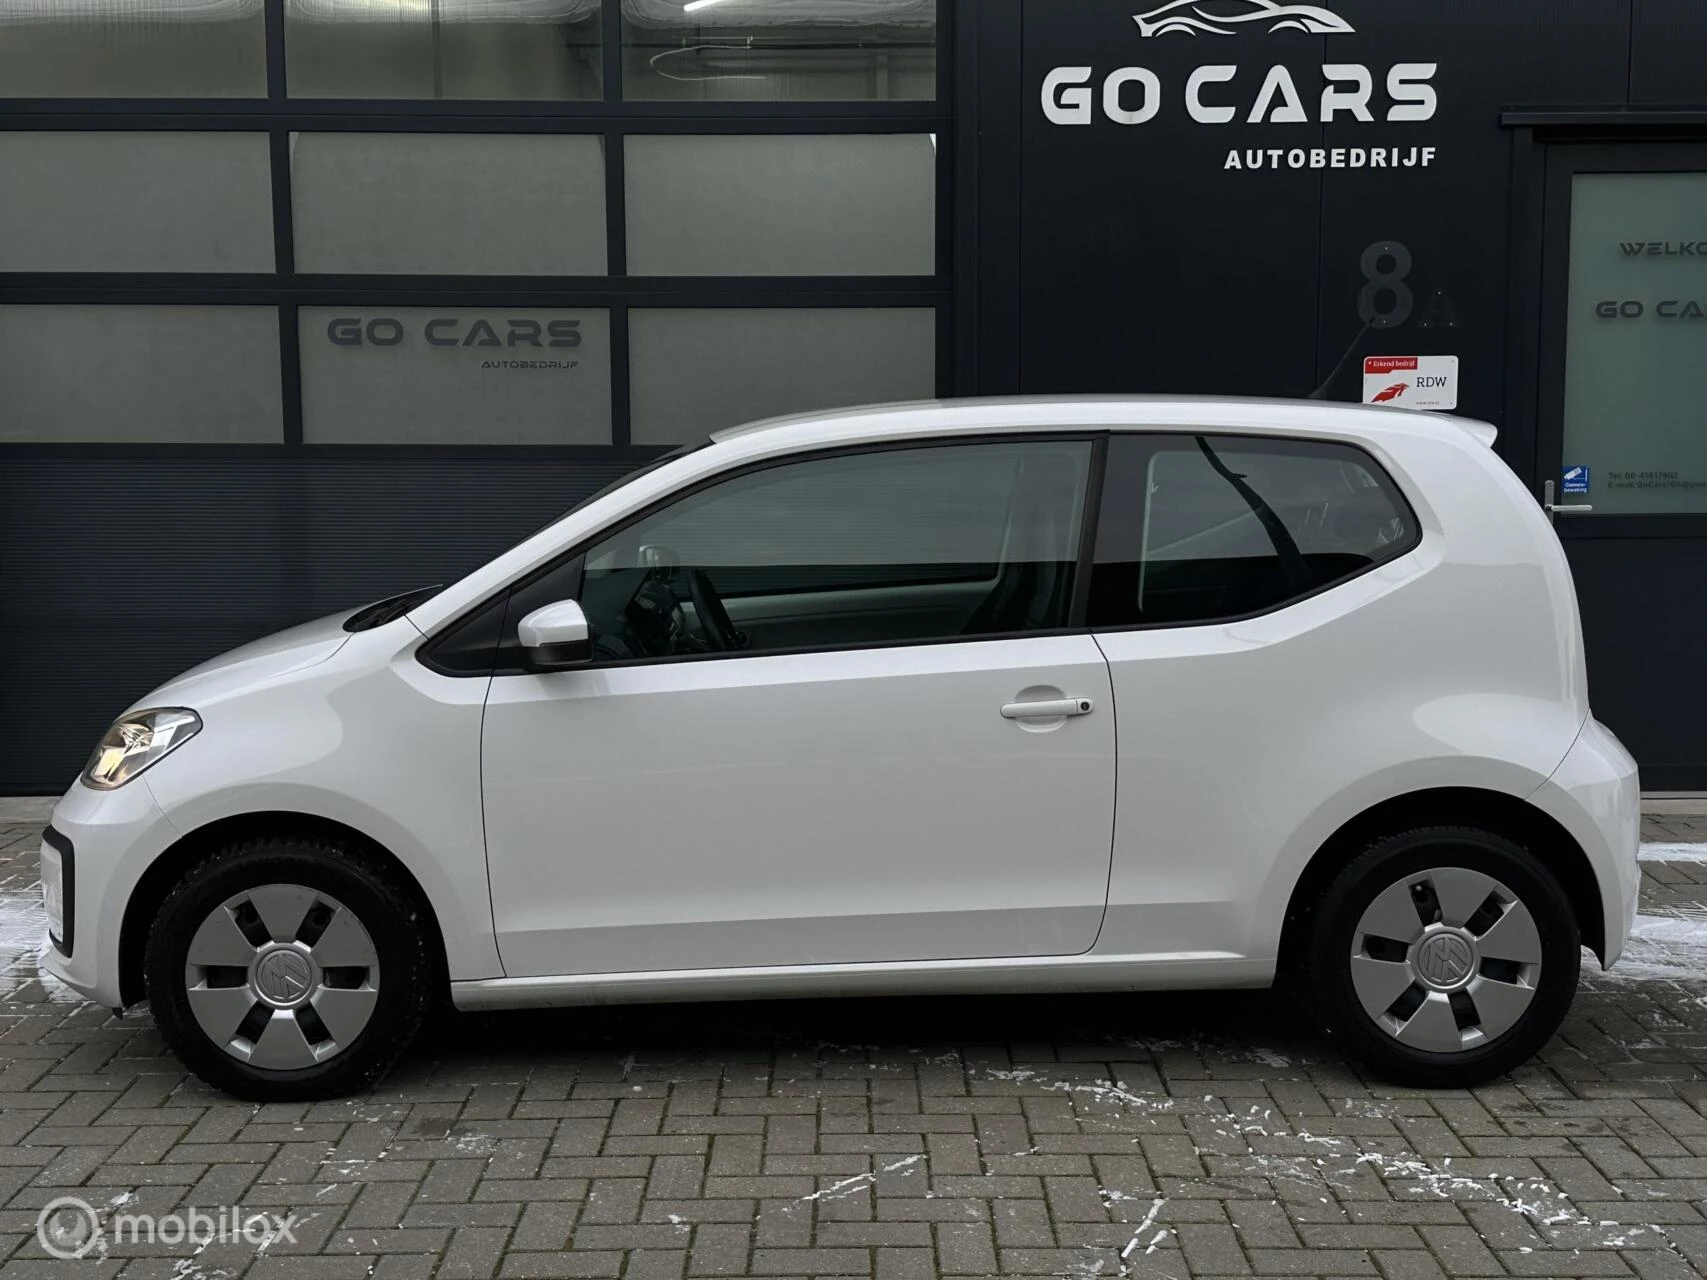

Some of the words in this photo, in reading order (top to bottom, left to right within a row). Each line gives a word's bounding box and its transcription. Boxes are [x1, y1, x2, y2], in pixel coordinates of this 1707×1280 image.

[1041, 66, 1161, 125] GO
[1185, 63, 1438, 124] CARS
[1223, 147, 1436, 169] AUTOBEDRIJF
[1595, 301, 1644, 318] GO
[327, 318, 404, 346] GO
[424, 319, 582, 347] CARS
[481, 360, 579, 369] AUTOBEDRIJF
[1416, 376, 1447, 388] RDW
